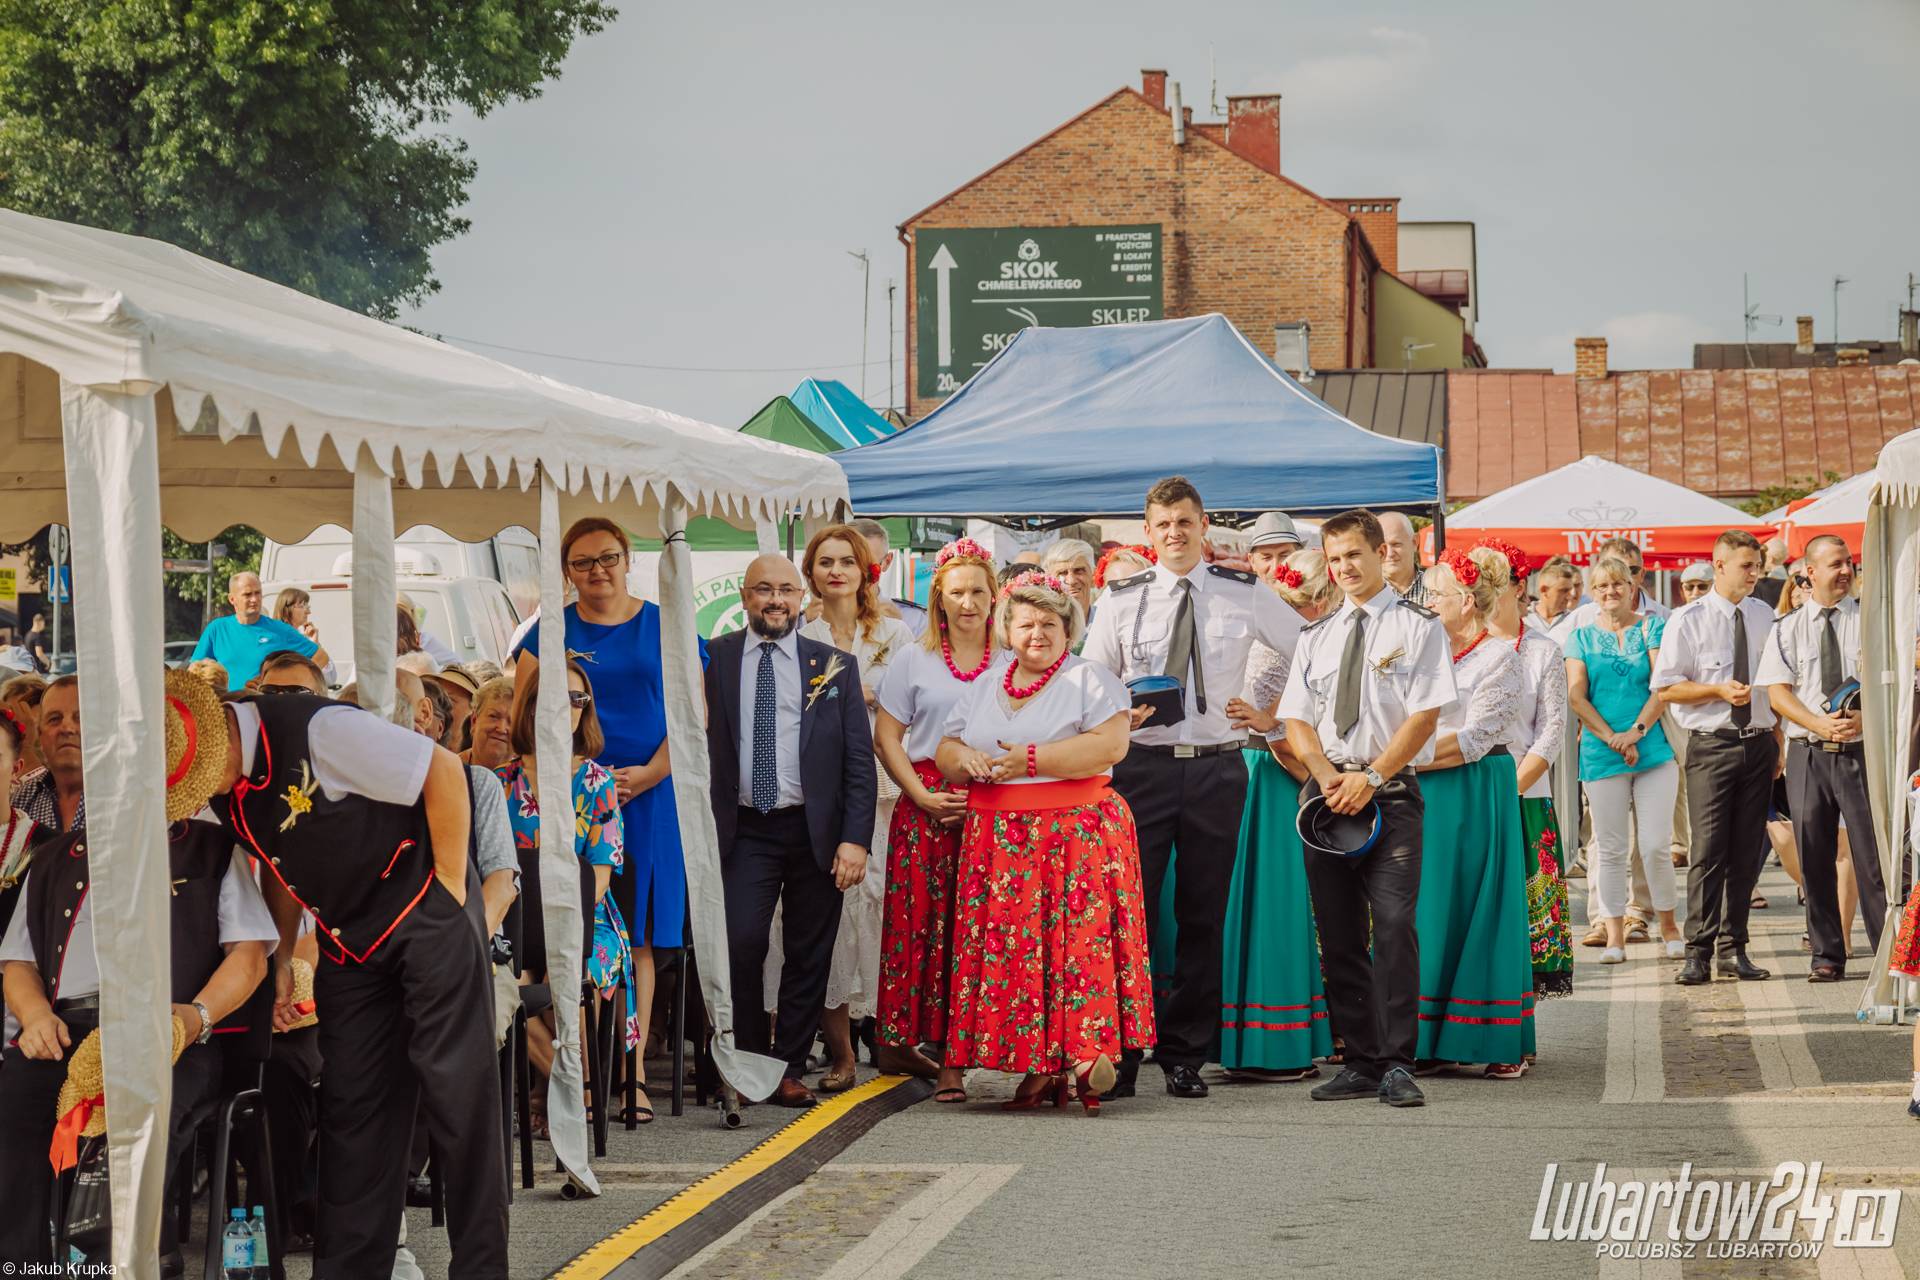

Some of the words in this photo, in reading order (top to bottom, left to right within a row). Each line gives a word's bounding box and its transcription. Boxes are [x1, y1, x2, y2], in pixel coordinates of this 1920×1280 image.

[1105, 232, 1152, 241] PRAKTYCZNE
[1123, 252, 1152, 261] LOKATY
[1000, 261, 1059, 279] SKOK
[1120, 263, 1152, 272] KREDYTY
[977, 279, 1082, 291] CHMIELEWSKIEGO
[1091, 308, 1150, 325] SKLEP
